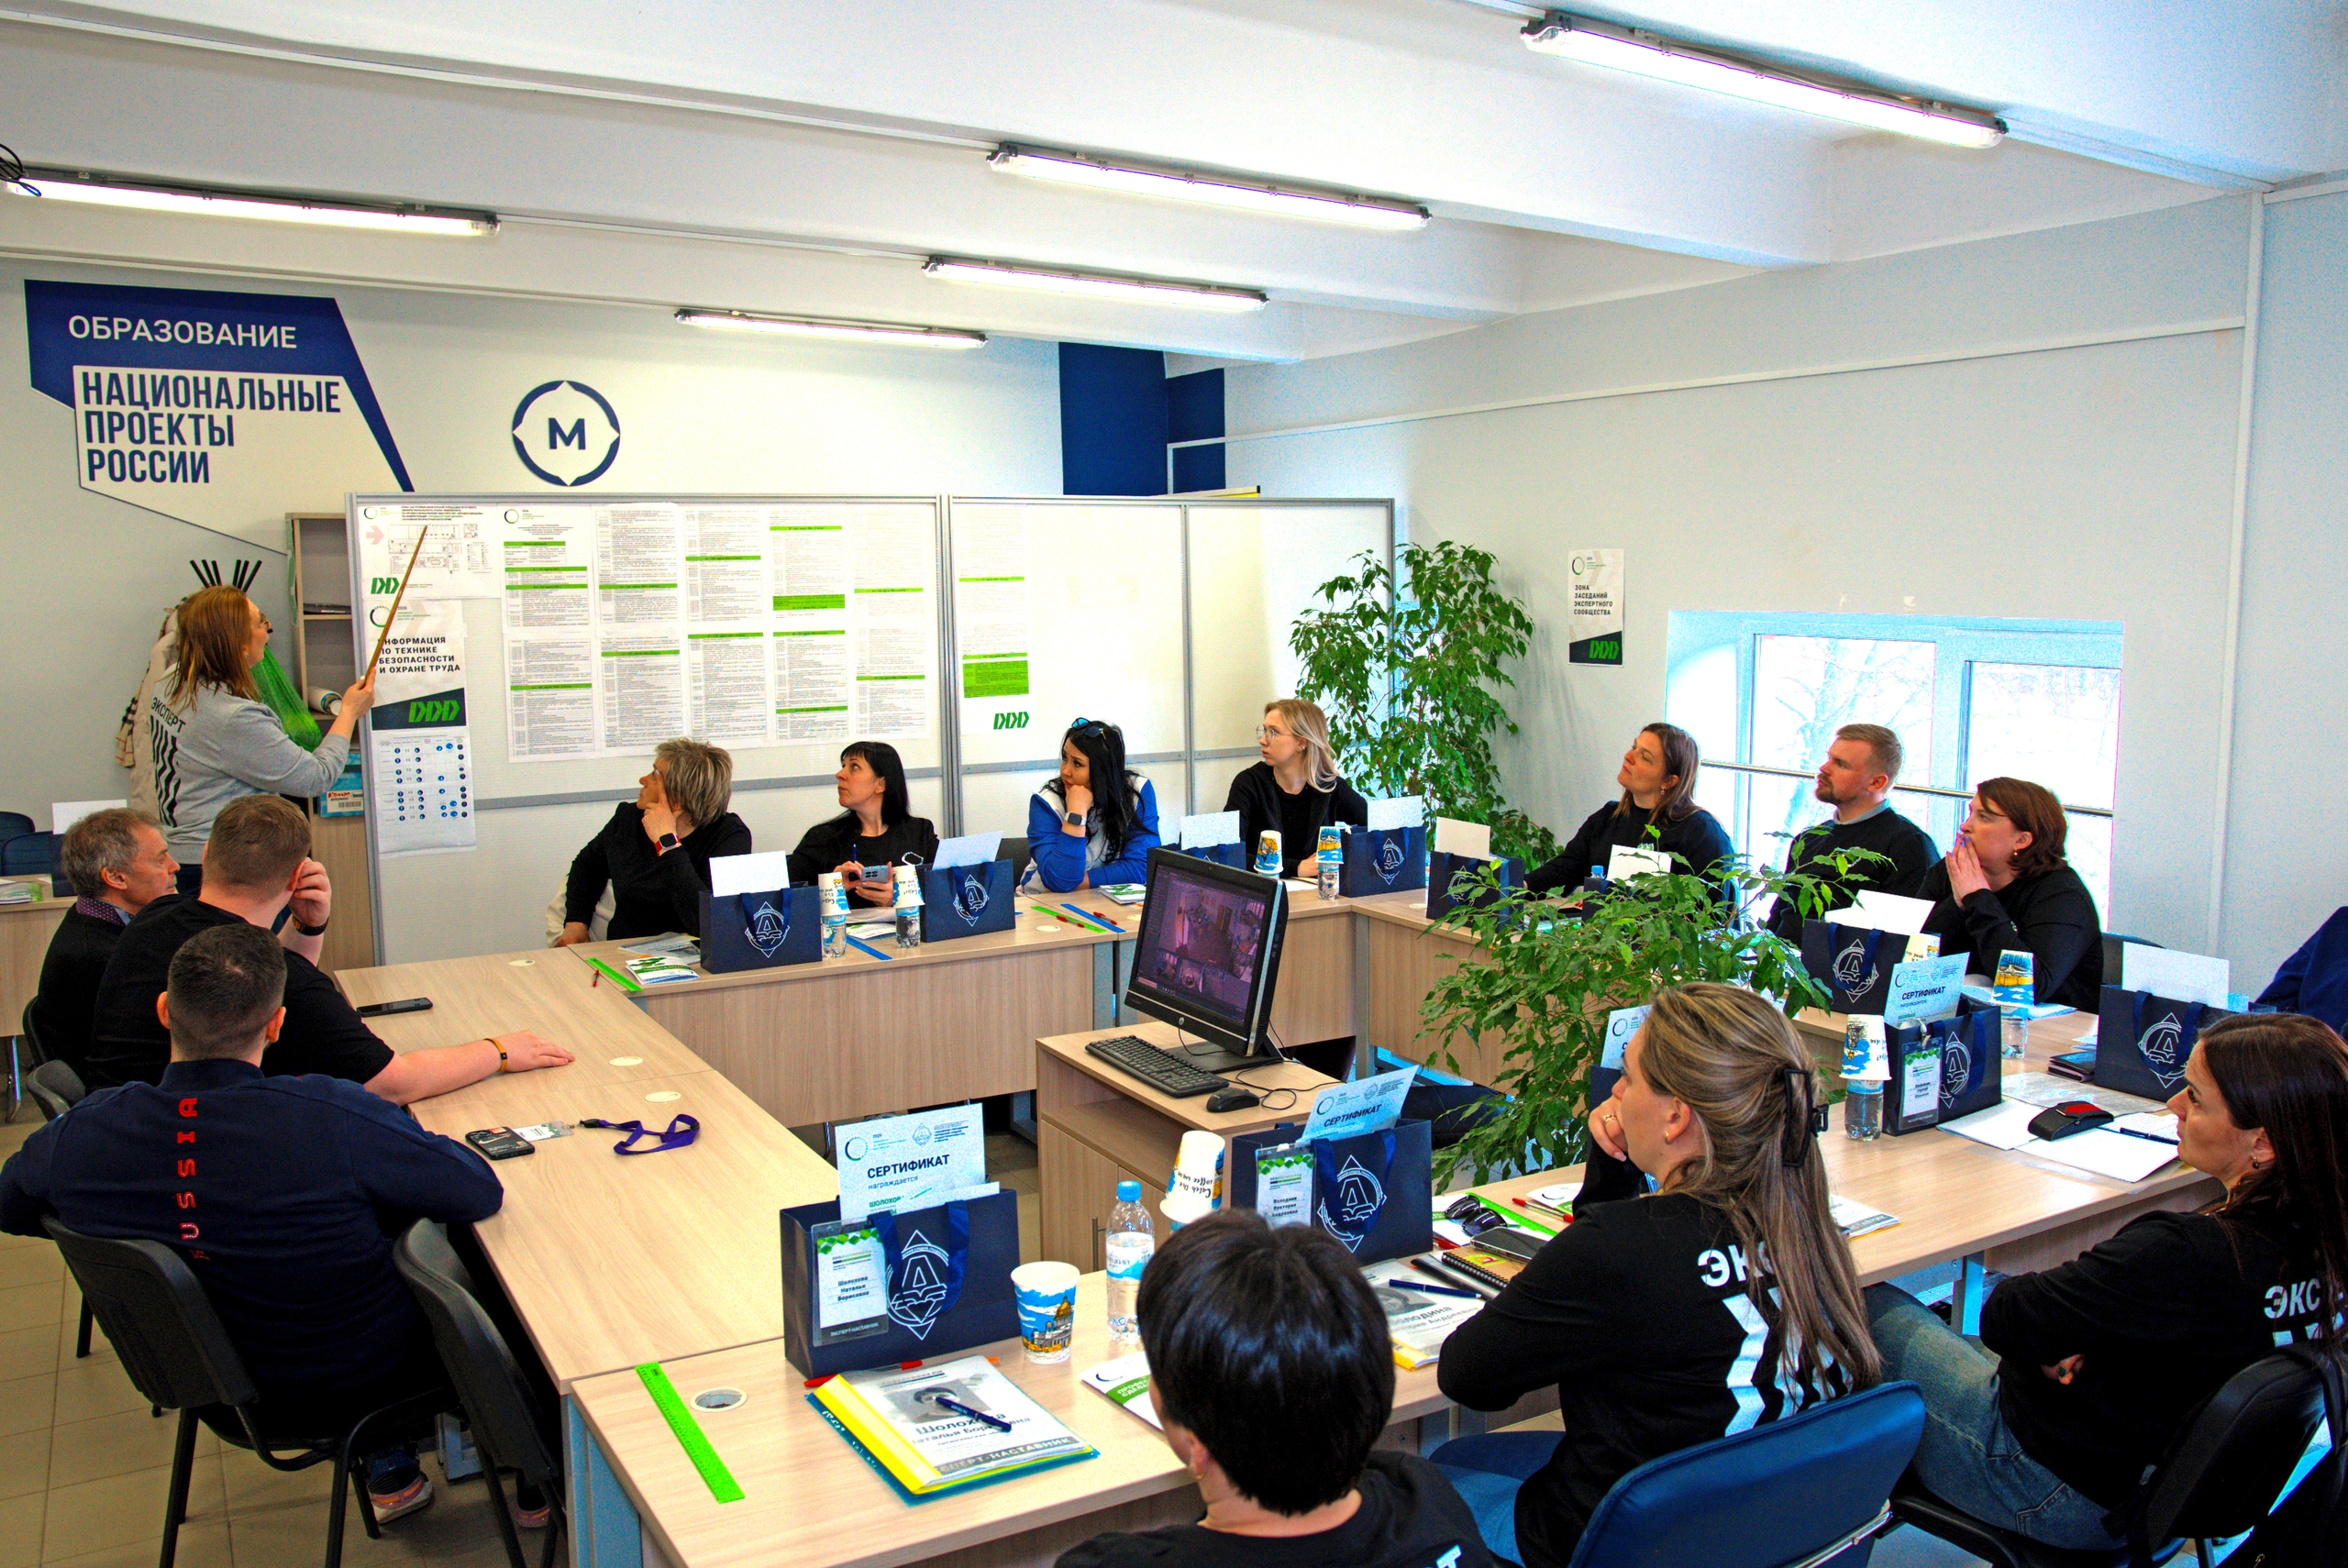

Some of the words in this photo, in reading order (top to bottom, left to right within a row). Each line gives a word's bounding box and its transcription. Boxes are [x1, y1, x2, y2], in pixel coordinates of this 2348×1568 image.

[68, 315, 298, 348] ОБРАЗОВАНИЕ
[82, 371, 341, 413] НАЦИОНАЛЬНЫЕ
[85, 411, 235, 447] ПРОЕКТЫ
[87, 448, 210, 483] РОССИИ
[378, 636, 446, 646] НФОРМАЦИЯ
[394, 646, 437, 654] ТЕХНИКЕ
[379, 655, 455, 665] БЕЗОПАСНОСТИ
[389, 666, 426, 674] ОХРАНЕ
[429, 664, 460, 673] ТРУДА
[150, 696, 186, 734] ЭКСПЕРТ
[1901, 986, 1946, 1000] СЕРТИФИКАТ
[1324, 1104, 1382, 1127] СЕРТИФИКАТ
[867, 1154, 950, 1178] СЕРТИФИКАТ
[868, 1175, 918, 1189] награждается
[837, 1291, 869, 1301] Борисовна
[840, 1284, 866, 1294] Наталья
